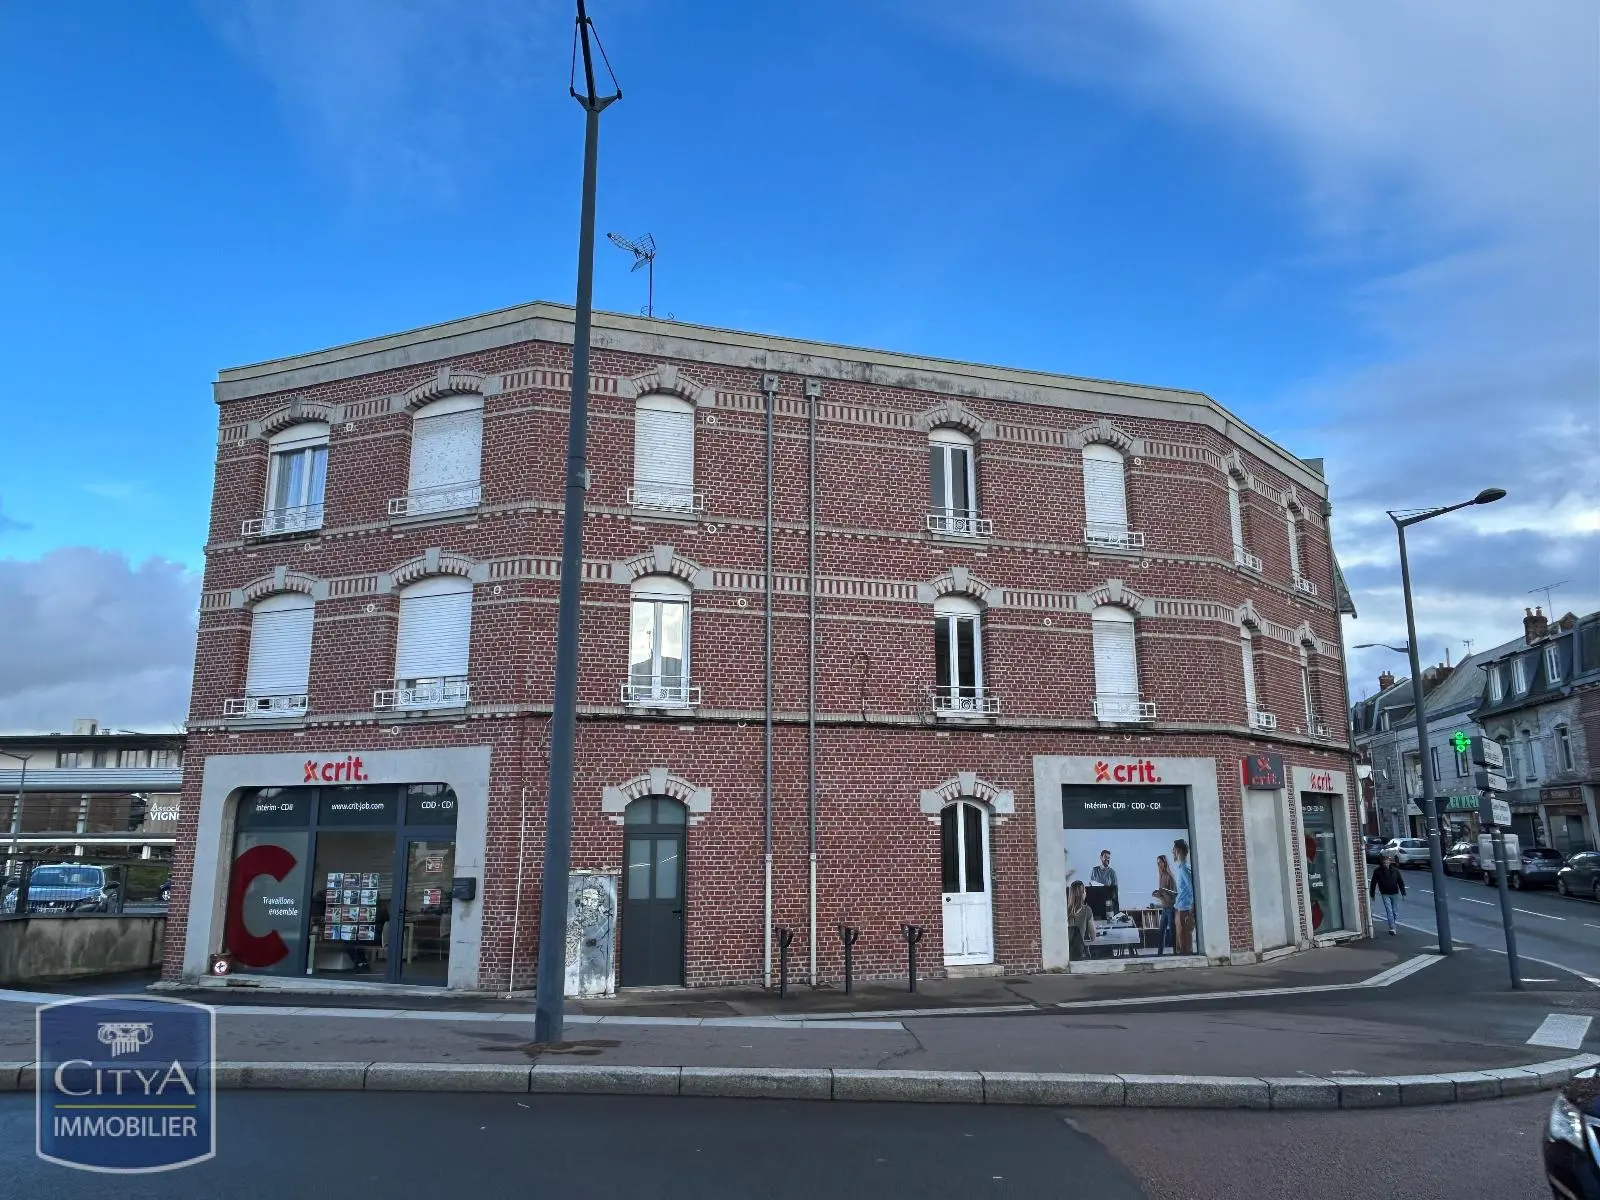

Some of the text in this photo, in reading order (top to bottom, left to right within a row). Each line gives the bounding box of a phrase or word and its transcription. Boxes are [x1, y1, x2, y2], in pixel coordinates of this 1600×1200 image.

[321, 755, 368, 782] crit.
[1113, 759, 1162, 782] crit.
[1084, 801, 1108, 809] Intérim
[268, 907, 299, 916] ensemble
